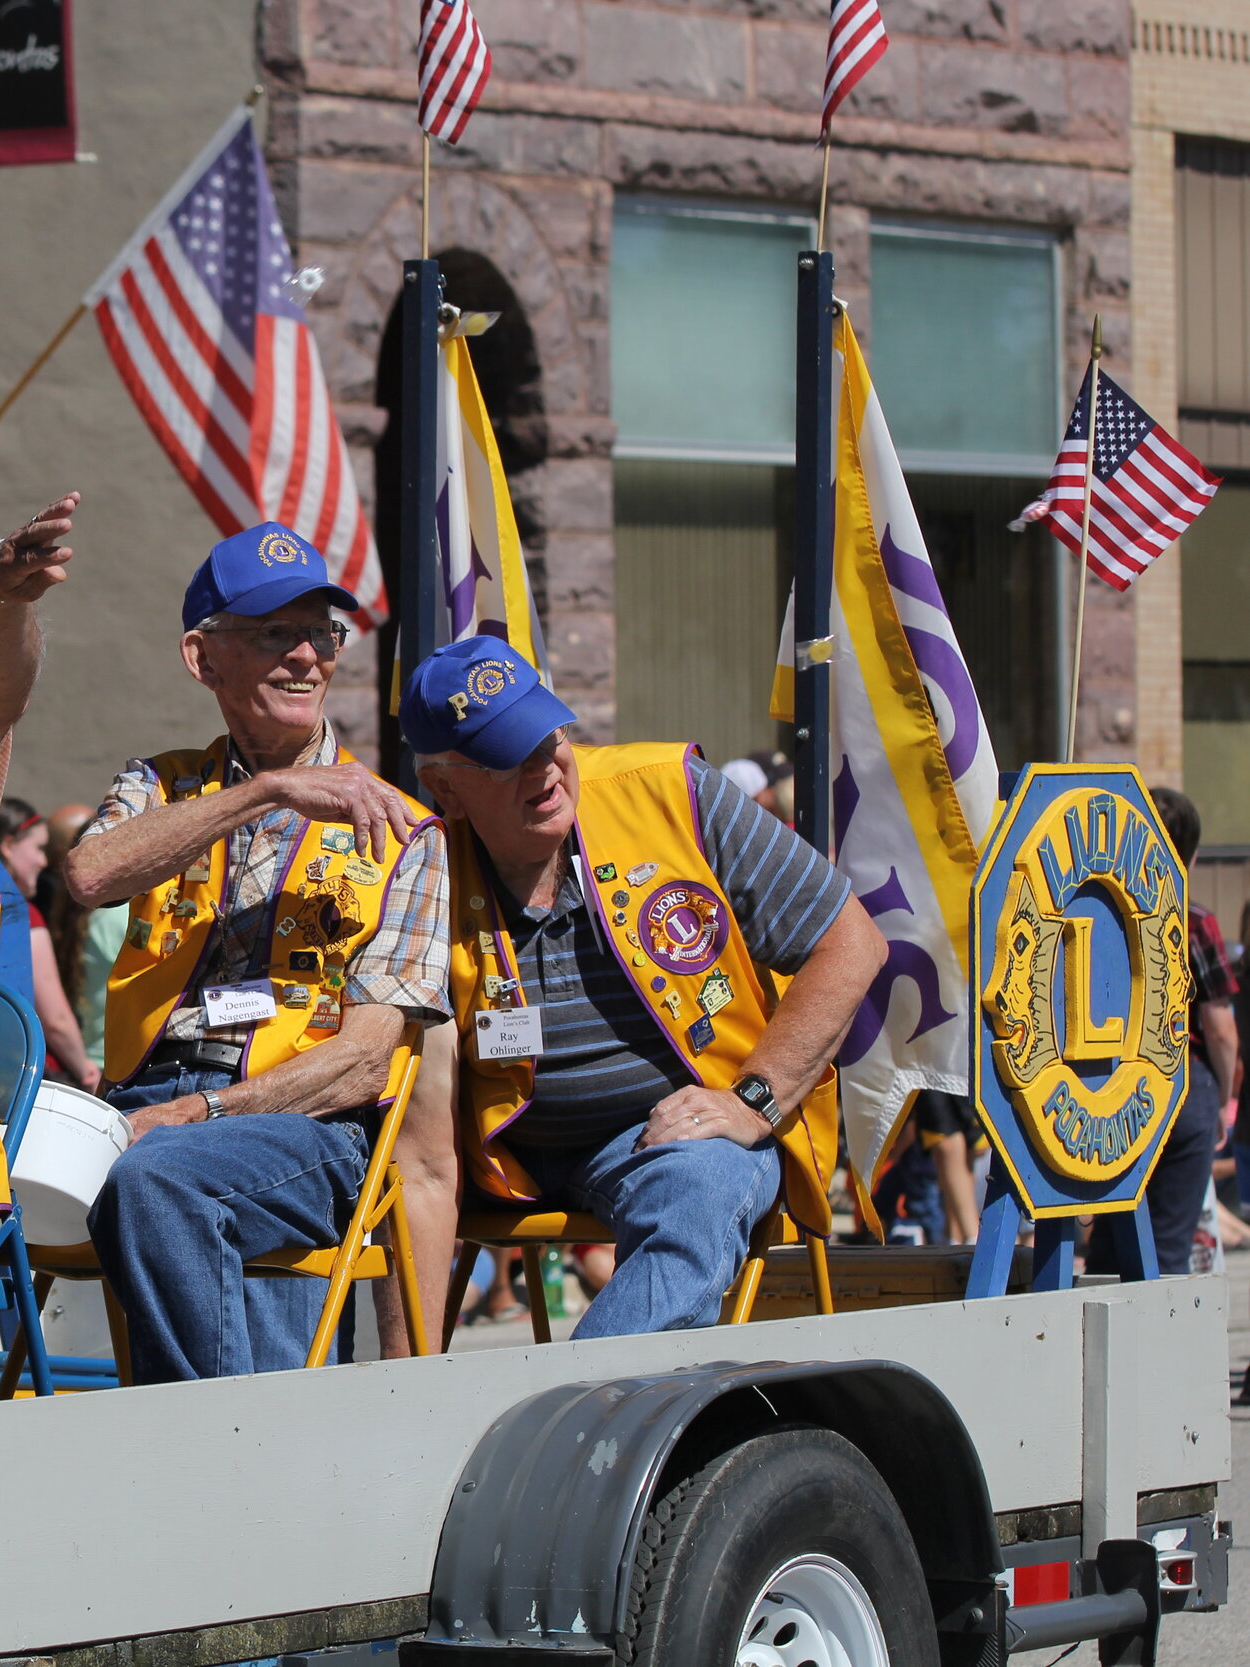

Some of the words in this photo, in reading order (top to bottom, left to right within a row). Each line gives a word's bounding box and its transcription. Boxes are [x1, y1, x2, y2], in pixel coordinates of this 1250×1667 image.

[467, 667, 489, 706] POCAHONTAS
[481, 660, 503, 669] LIONS
[1037, 794, 1168, 915] LIONS
[651, 890, 686, 920] LIONS
[667, 913, 699, 944] L
[1062, 916, 1125, 1061] L
[218, 1008, 270, 1023] Nagengast
[224, 999, 260, 1011] Dennis
[490, 1044, 532, 1056] Ohlinger
[500, 1032, 519, 1043] Ray
[1042, 1075, 1155, 1166] POCAHONTAS
